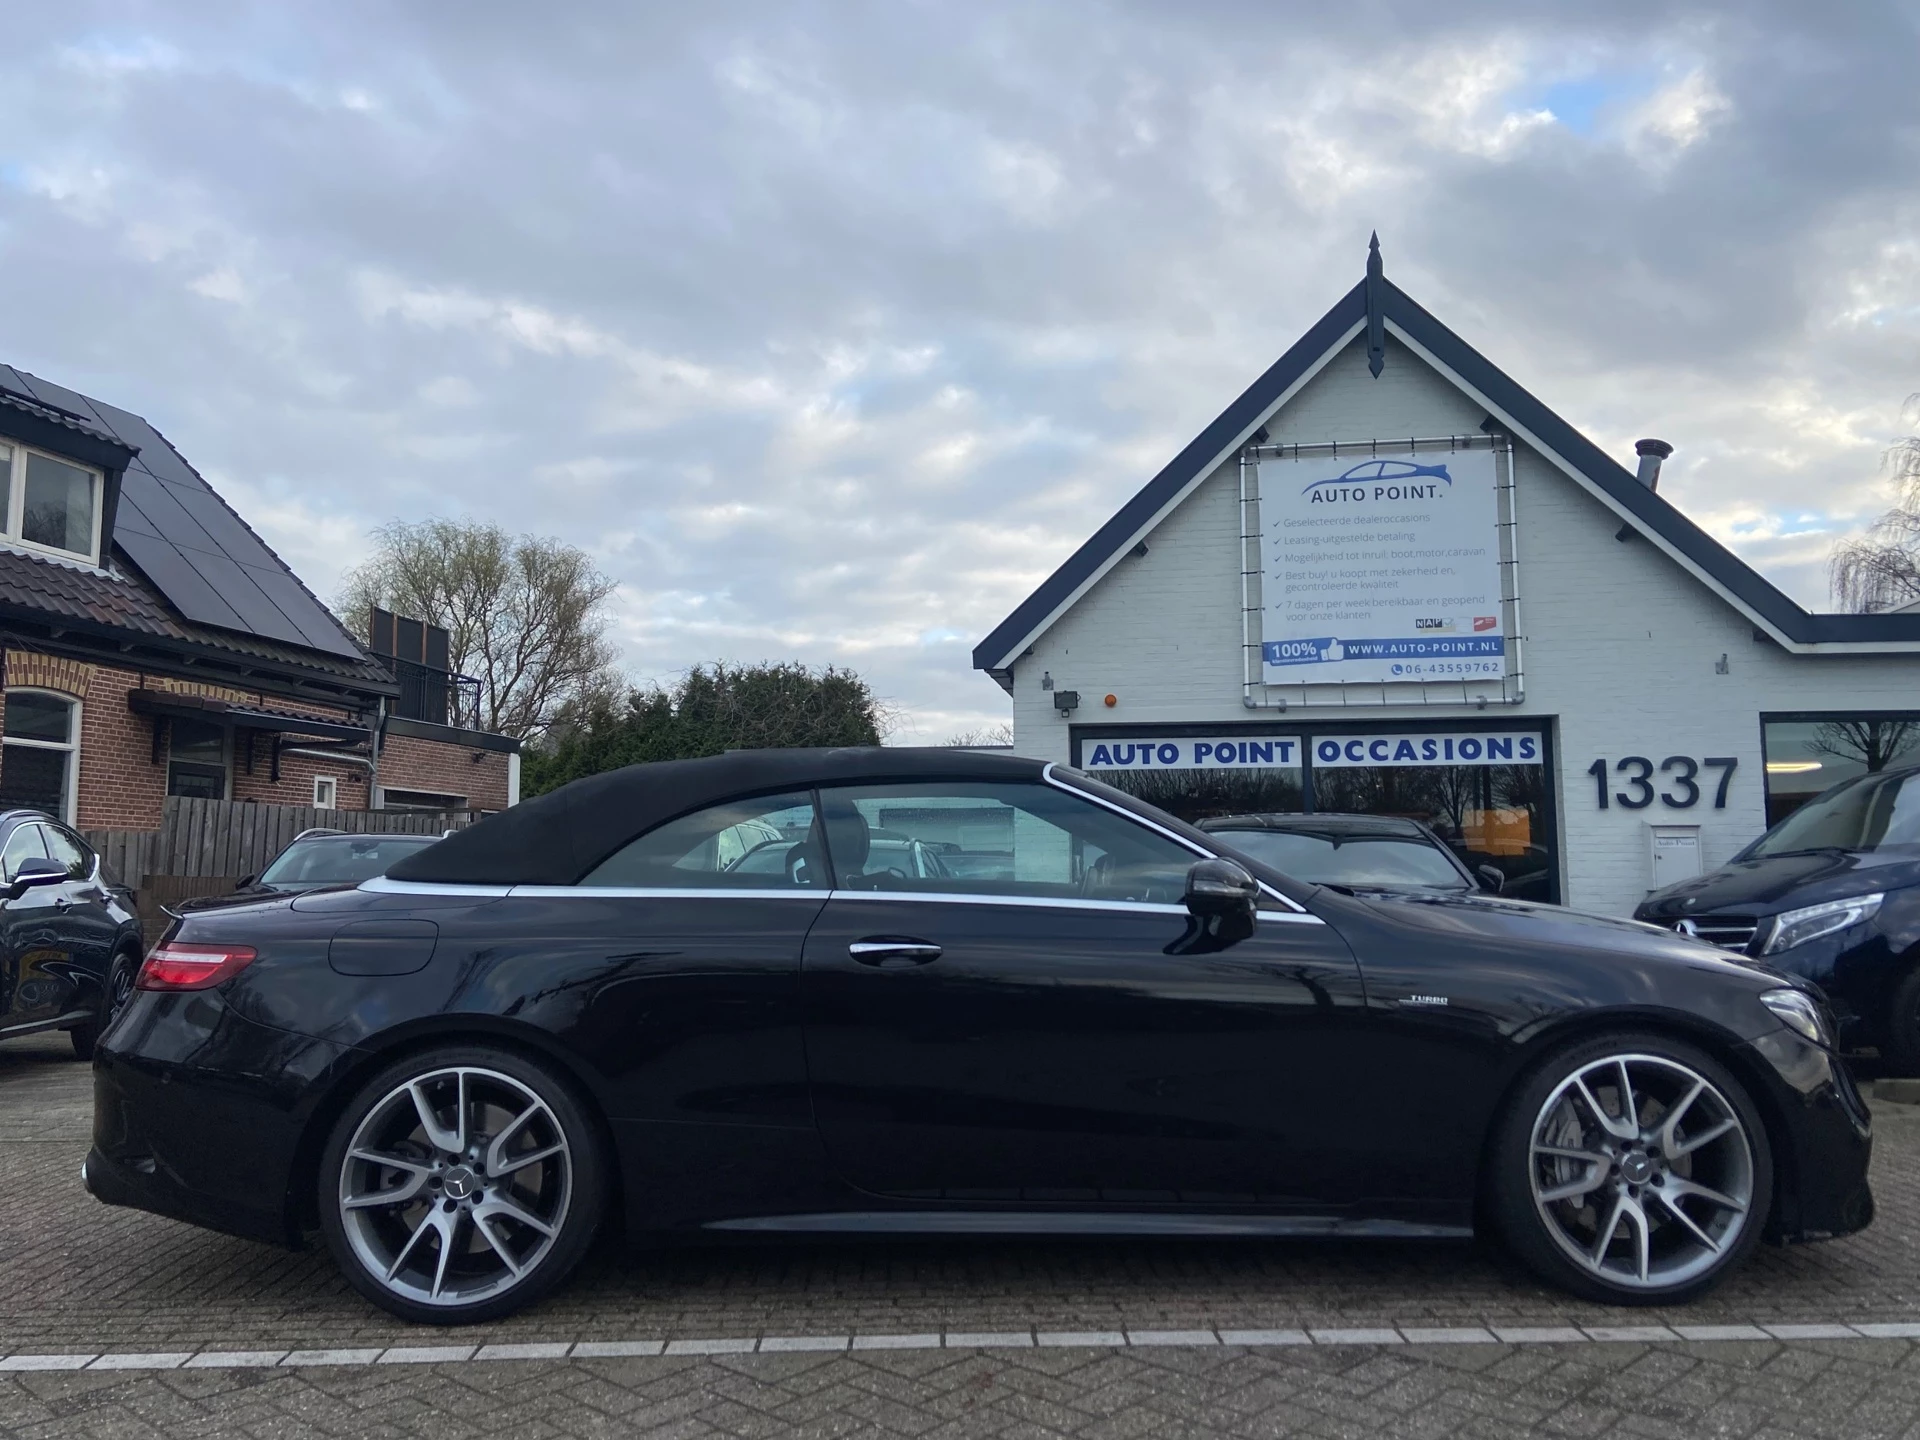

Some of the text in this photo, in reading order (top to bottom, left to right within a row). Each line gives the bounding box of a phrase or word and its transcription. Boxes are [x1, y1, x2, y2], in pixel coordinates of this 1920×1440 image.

[1311, 489, 1366, 503] AUTO
[1284, 514, 1431, 528] Geselecteerde dealeroccasions
[1284, 532, 1416, 546] Leasing-uitgestelde betaling
[1285, 551, 1344, 564] Mogelijkheid
[1346, 552, 1360, 561] tot
[1285, 571, 1306, 580] Best
[1339, 569, 1367, 580] koopt
[1370, 569, 1388, 577] met
[1391, 566, 1438, 577] zekerheid
[1285, 580, 1398, 594] gecontroleerde kwaliteit
[1294, 600, 1324, 611] dagen
[1326, 600, 1343, 610] per
[1345, 598, 1370, 608] week
[1372, 596, 1424, 607] bereikbaar
[1427, 597, 1439, 605] en
[1441, 595, 1486, 607] geopend
[1286, 610, 1371, 621] voor onze klanten
[1416, 618, 1443, 629] NAP
[1272, 642, 1317, 658] 100%
[1349, 642, 1498, 655] WWW.AUTO-POINT.NL
[1405, 662, 1499, 675] 06-43559762
[1089, 737, 1536, 765] AUTO POINT OCCASIONS
[1587, 755, 1739, 809] 1337
